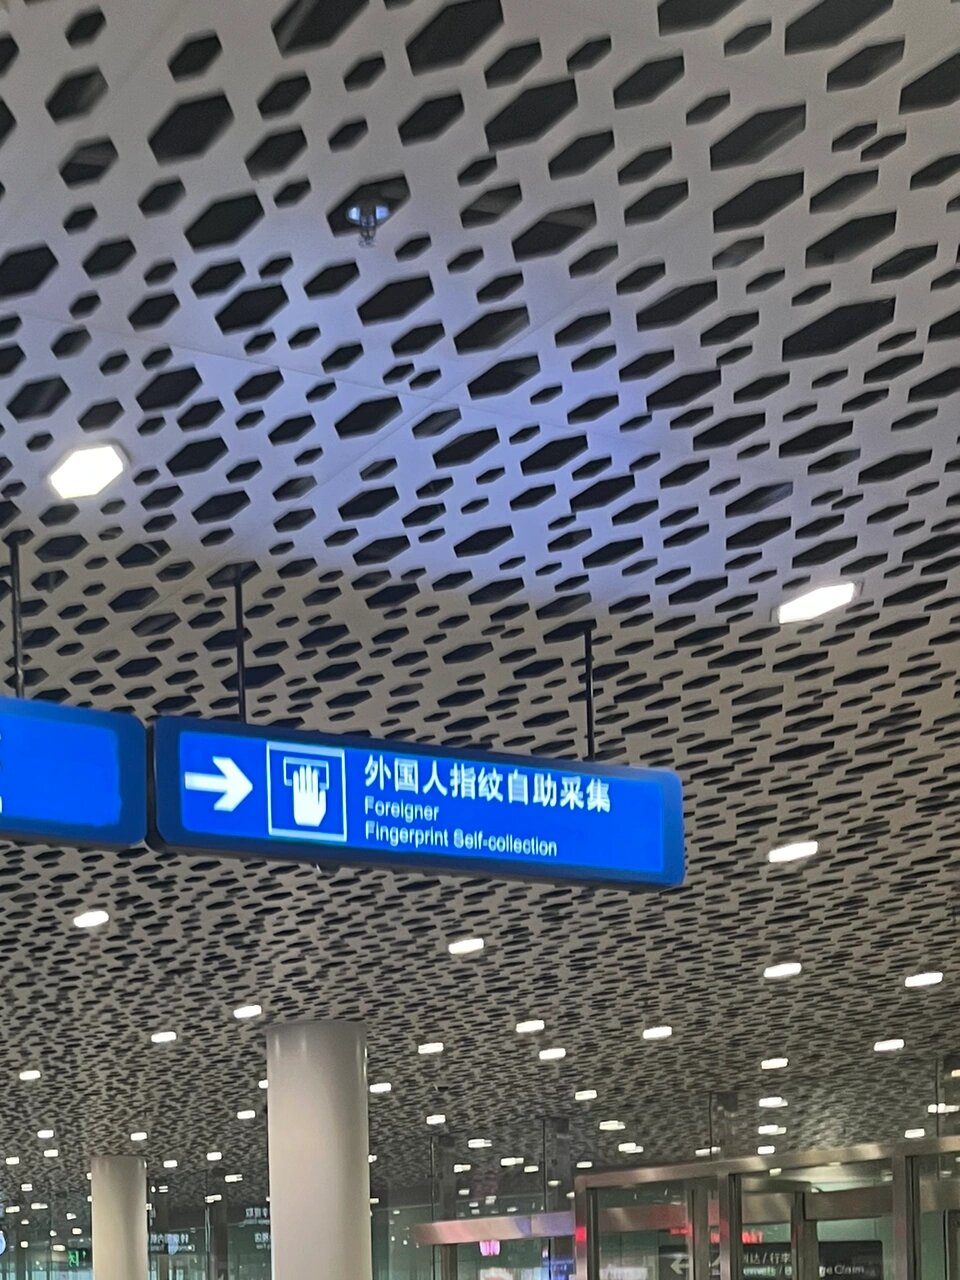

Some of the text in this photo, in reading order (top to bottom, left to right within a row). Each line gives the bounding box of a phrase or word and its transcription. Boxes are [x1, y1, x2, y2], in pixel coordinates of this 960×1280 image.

[364, 755, 611, 813] 外国人指纹自助采集
[364, 797, 440, 822] Foreigner
[364, 820, 558, 857] Fingerprint Self-collection
